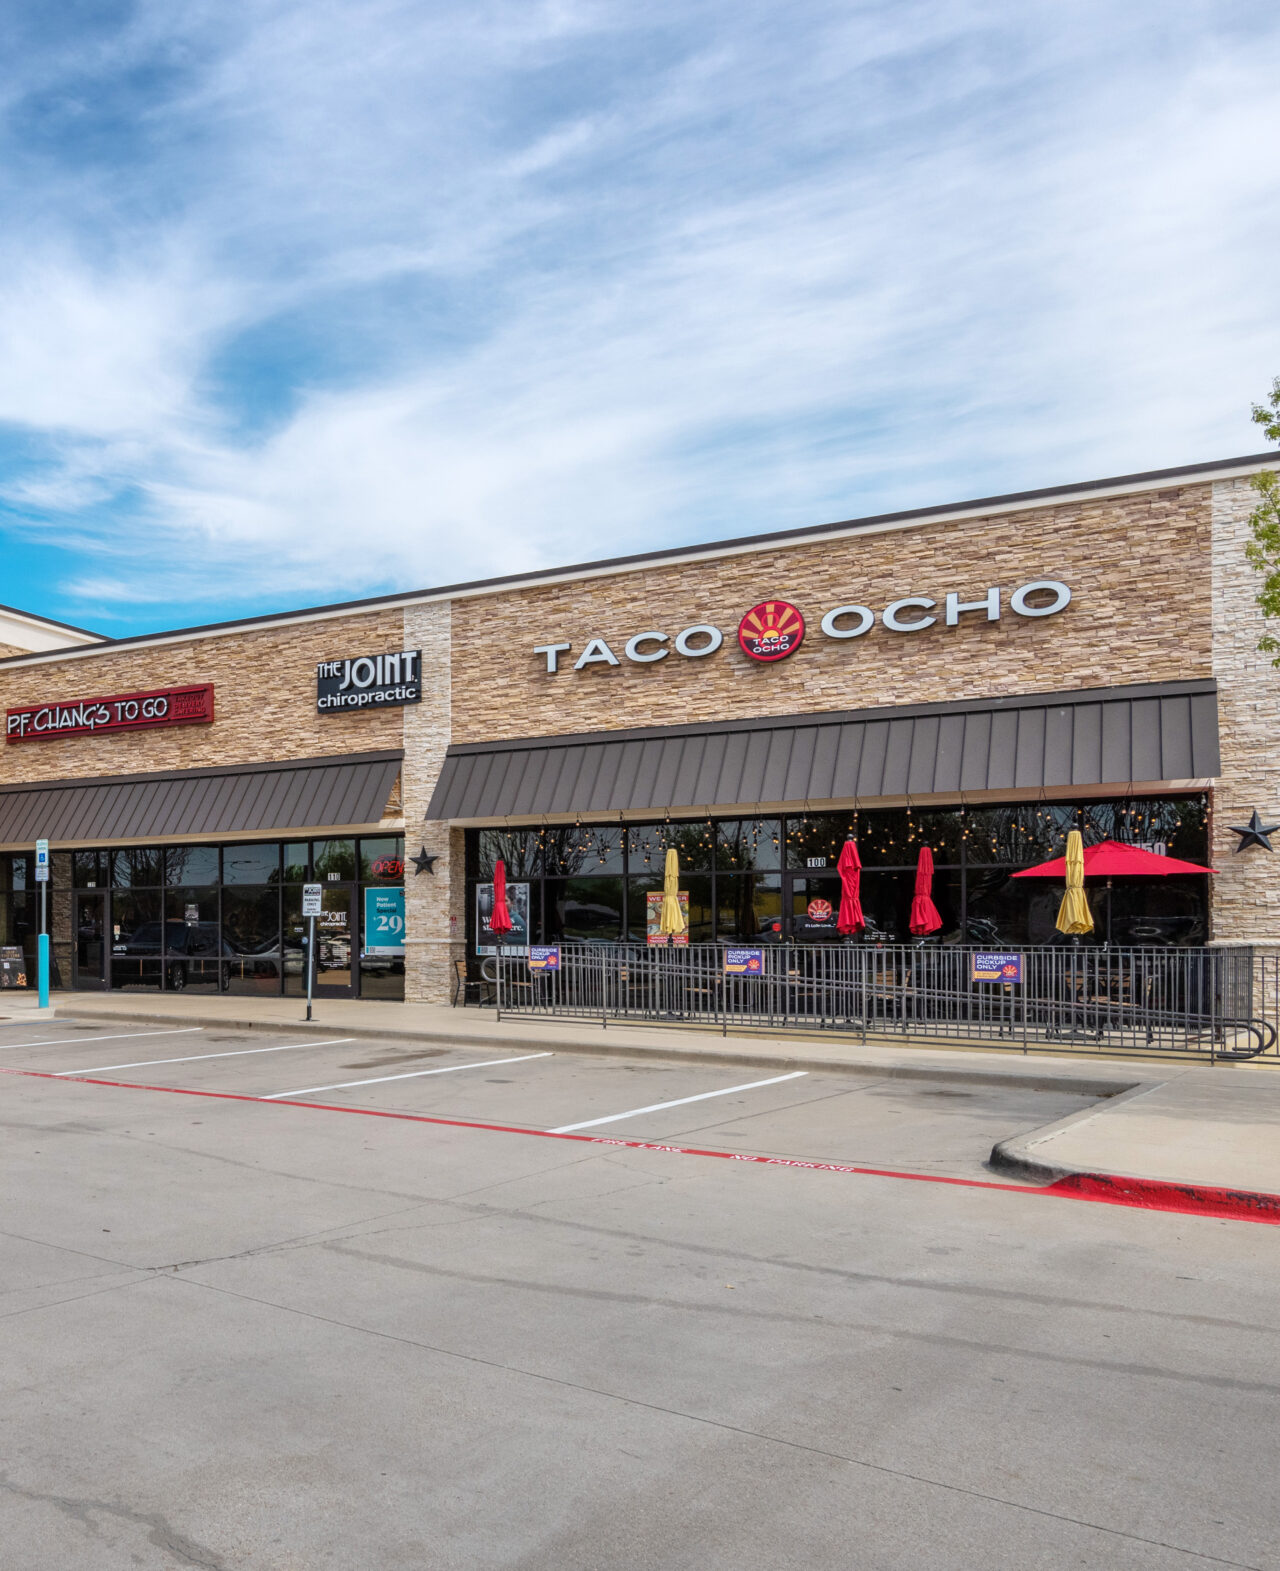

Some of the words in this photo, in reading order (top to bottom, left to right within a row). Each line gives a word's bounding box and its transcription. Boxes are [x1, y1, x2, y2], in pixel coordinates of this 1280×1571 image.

[534, 625, 723, 673] TACO
[821, 580, 1072, 640] OCHO
[753, 635, 789, 645] TACO
[753, 643, 790, 653] OCHO
[317, 661, 341, 678] THE
[318, 685, 416, 707] chiropractic
[34, 702, 110, 730] CHANG'S
[115, 701, 138, 721] TO
[142, 697, 168, 718] GO
[373, 861, 404, 873] OPEN
[808, 856, 826, 867] 100
